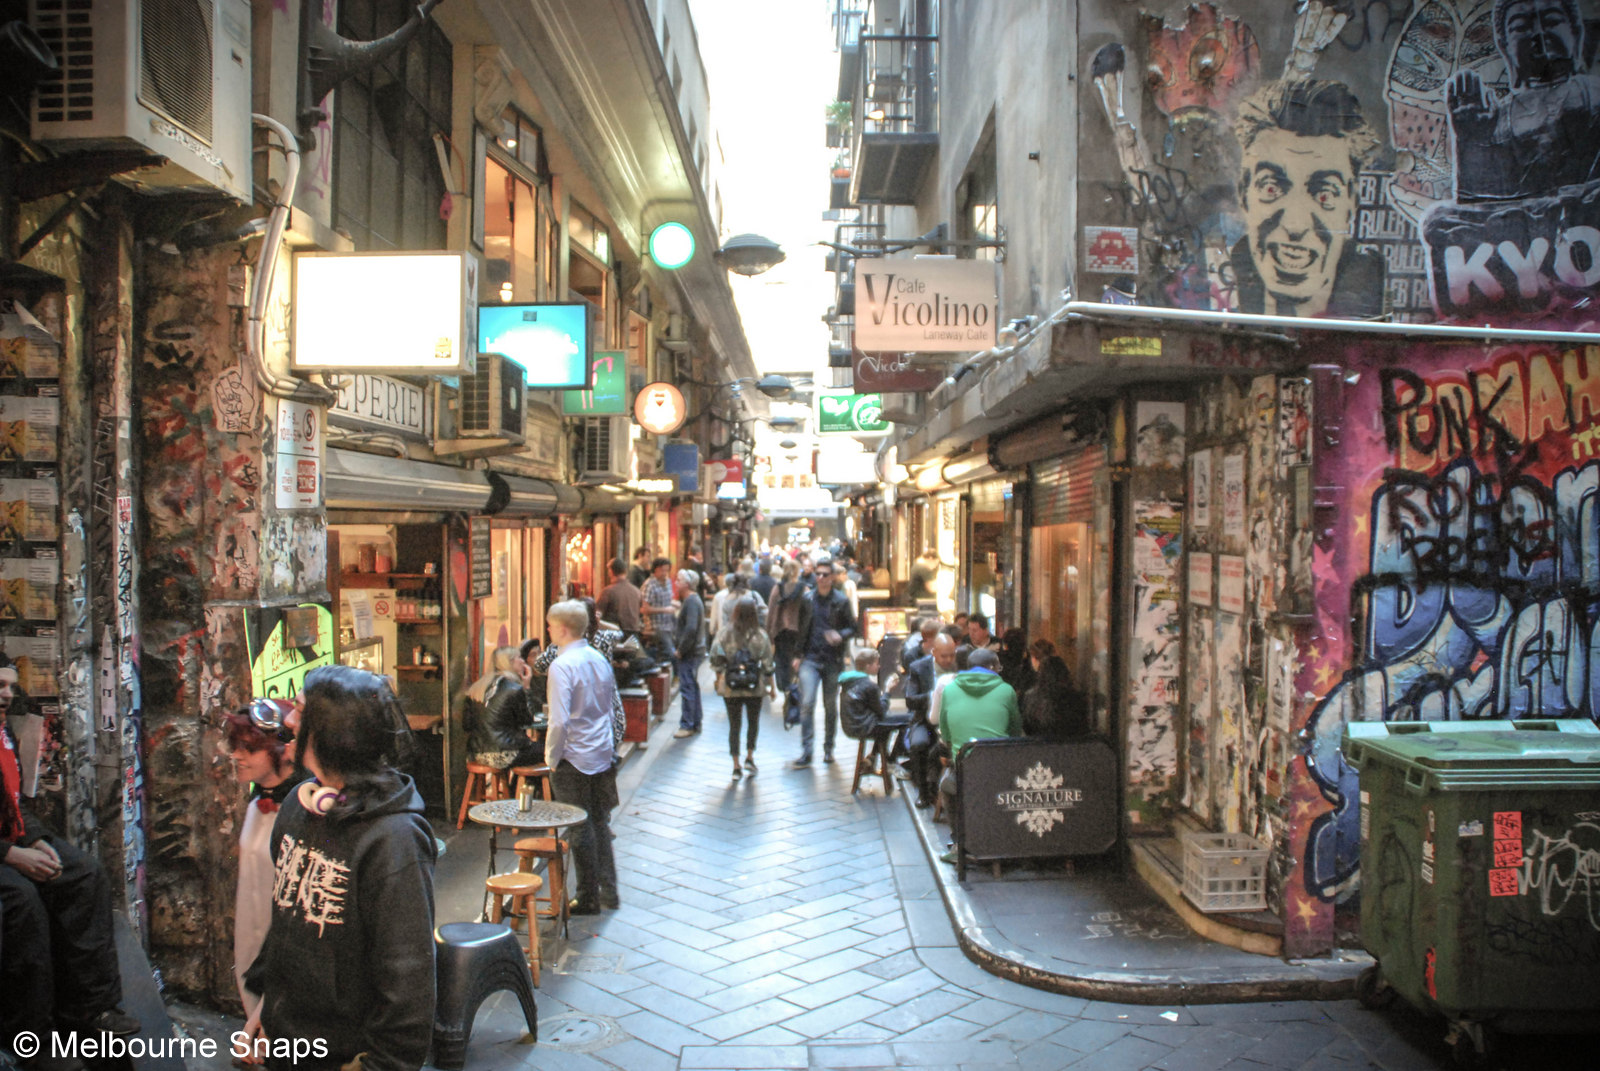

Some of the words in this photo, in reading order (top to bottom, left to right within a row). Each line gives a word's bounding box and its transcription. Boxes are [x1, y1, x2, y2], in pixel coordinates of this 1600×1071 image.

[1444, 225, 1600, 305] KYO
[862, 273, 989, 327] Vicolino
[896, 278, 926, 294] Cafe
[923, 329, 964, 342] Laneway
[966, 329, 989, 340] Cafe
[1379, 366, 1522, 457] PUNK
[996, 789, 1083, 805] SIGNATURE
